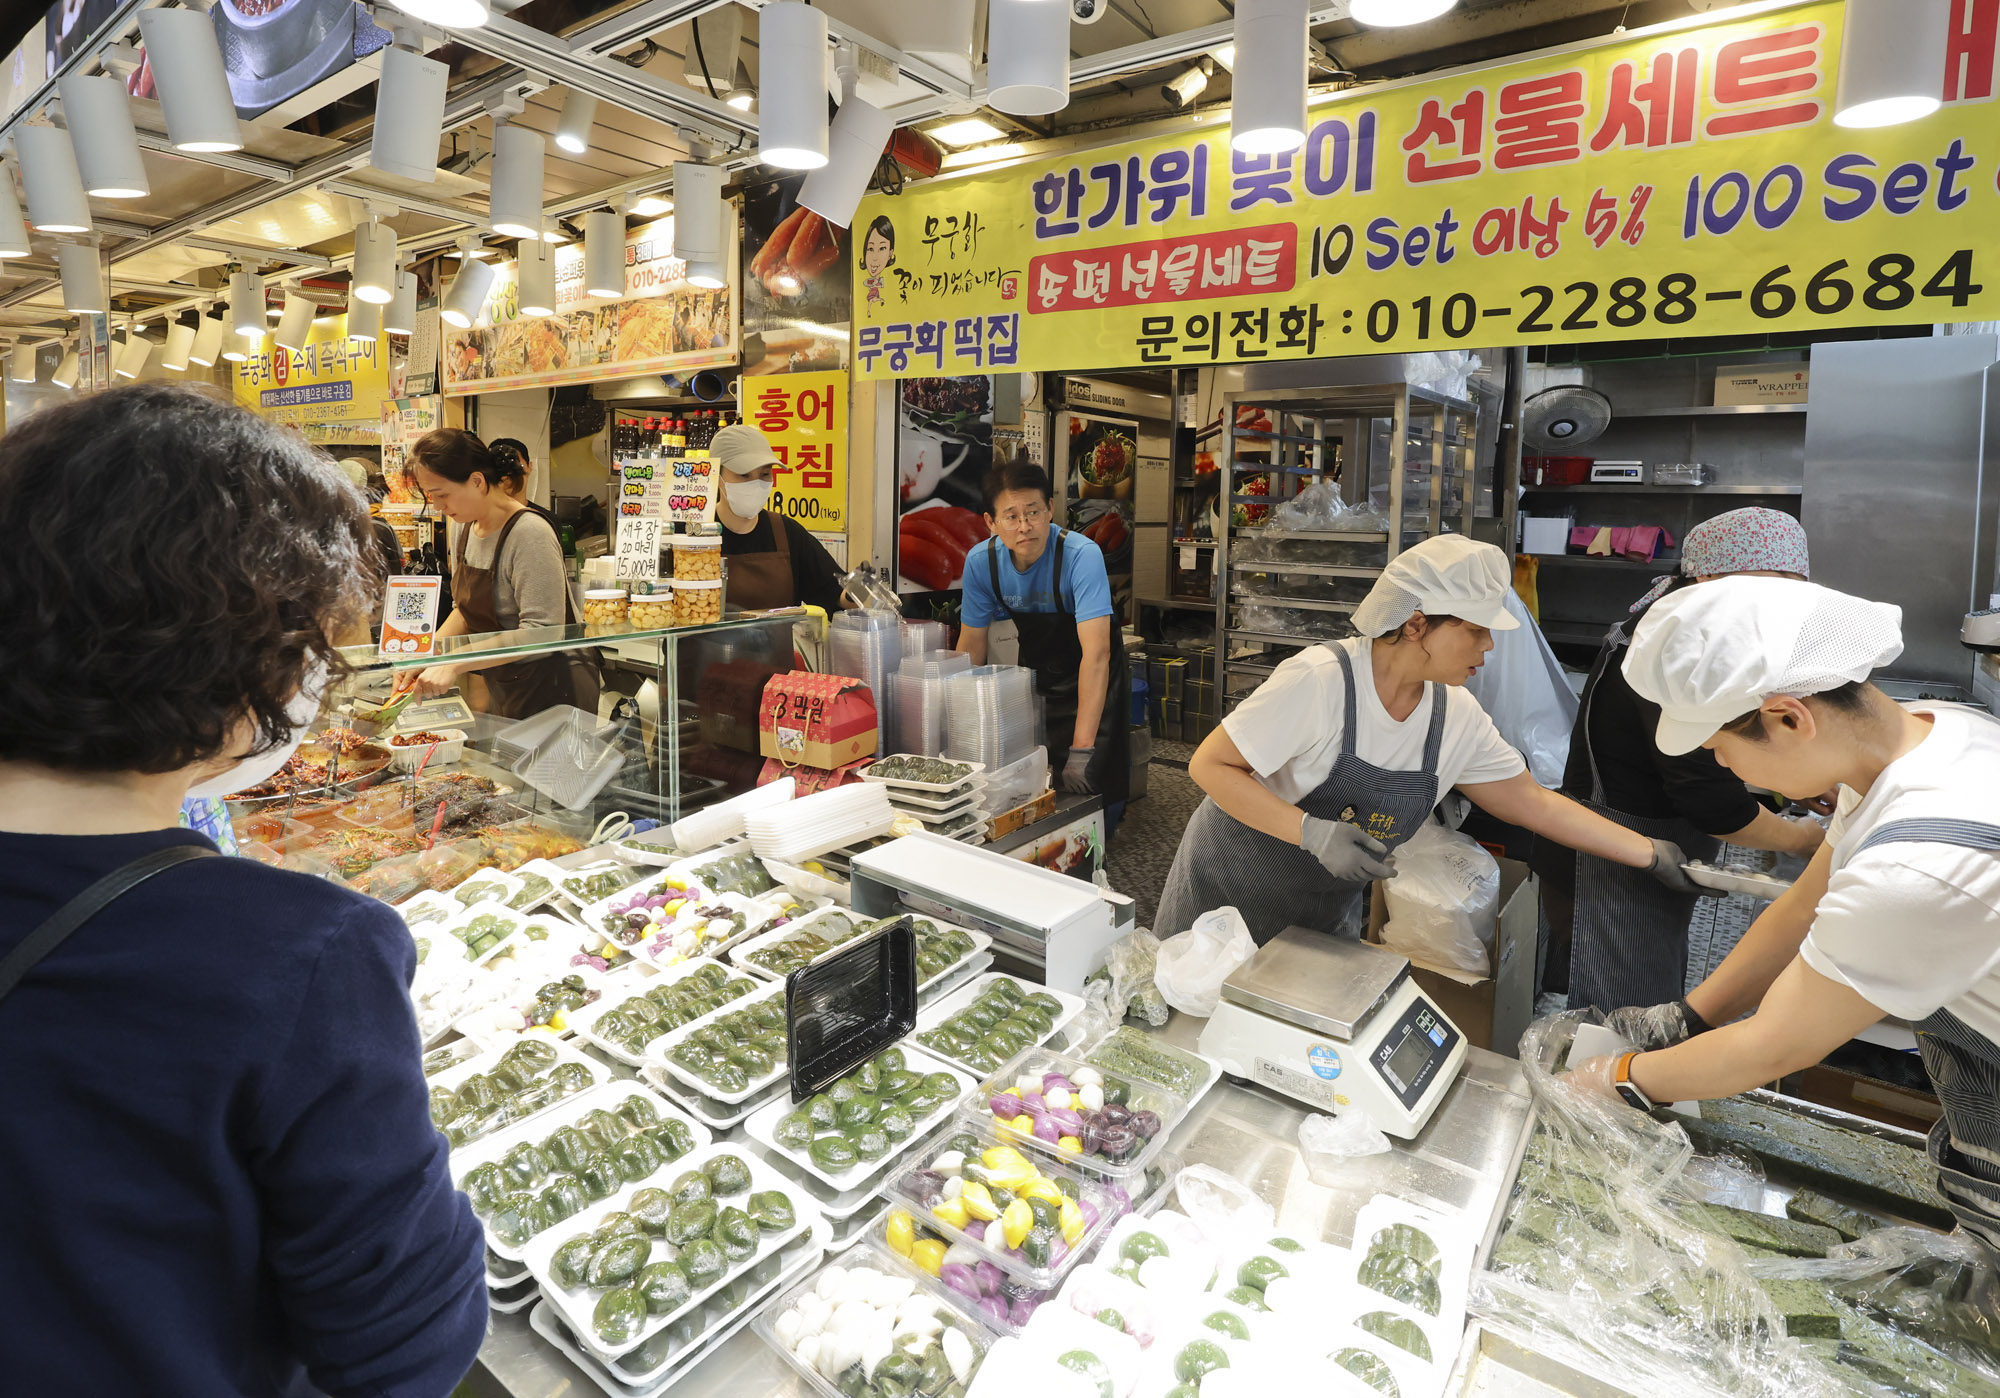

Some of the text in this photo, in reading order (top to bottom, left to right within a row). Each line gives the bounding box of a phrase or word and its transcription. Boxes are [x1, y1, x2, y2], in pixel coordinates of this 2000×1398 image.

[1034, 144, 1207, 239] 한가위
[1403, 26, 1820, 184] 선물세트
[1311, 139, 1974, 278] 10 Set 이상 5% 100 Set
[922, 211, 986, 267] 무궁화
[1037, 239, 1284, 309] 송편 선물세트
[1136, 303, 1324, 362] 문의전화
[1366, 249, 1982, 343] 010-2288-6684
[276, 350, 287, 380] 김
[292, 343, 317, 381] 수제
[858, 313, 1020, 372] 무궁화 떡집
[755, 384, 834, 433] 홍어
[672, 461, 712, 479] 간장게장
[1263, 1063, 1283, 1076] CAS
[1379, 1044, 1393, 1061] CAS
